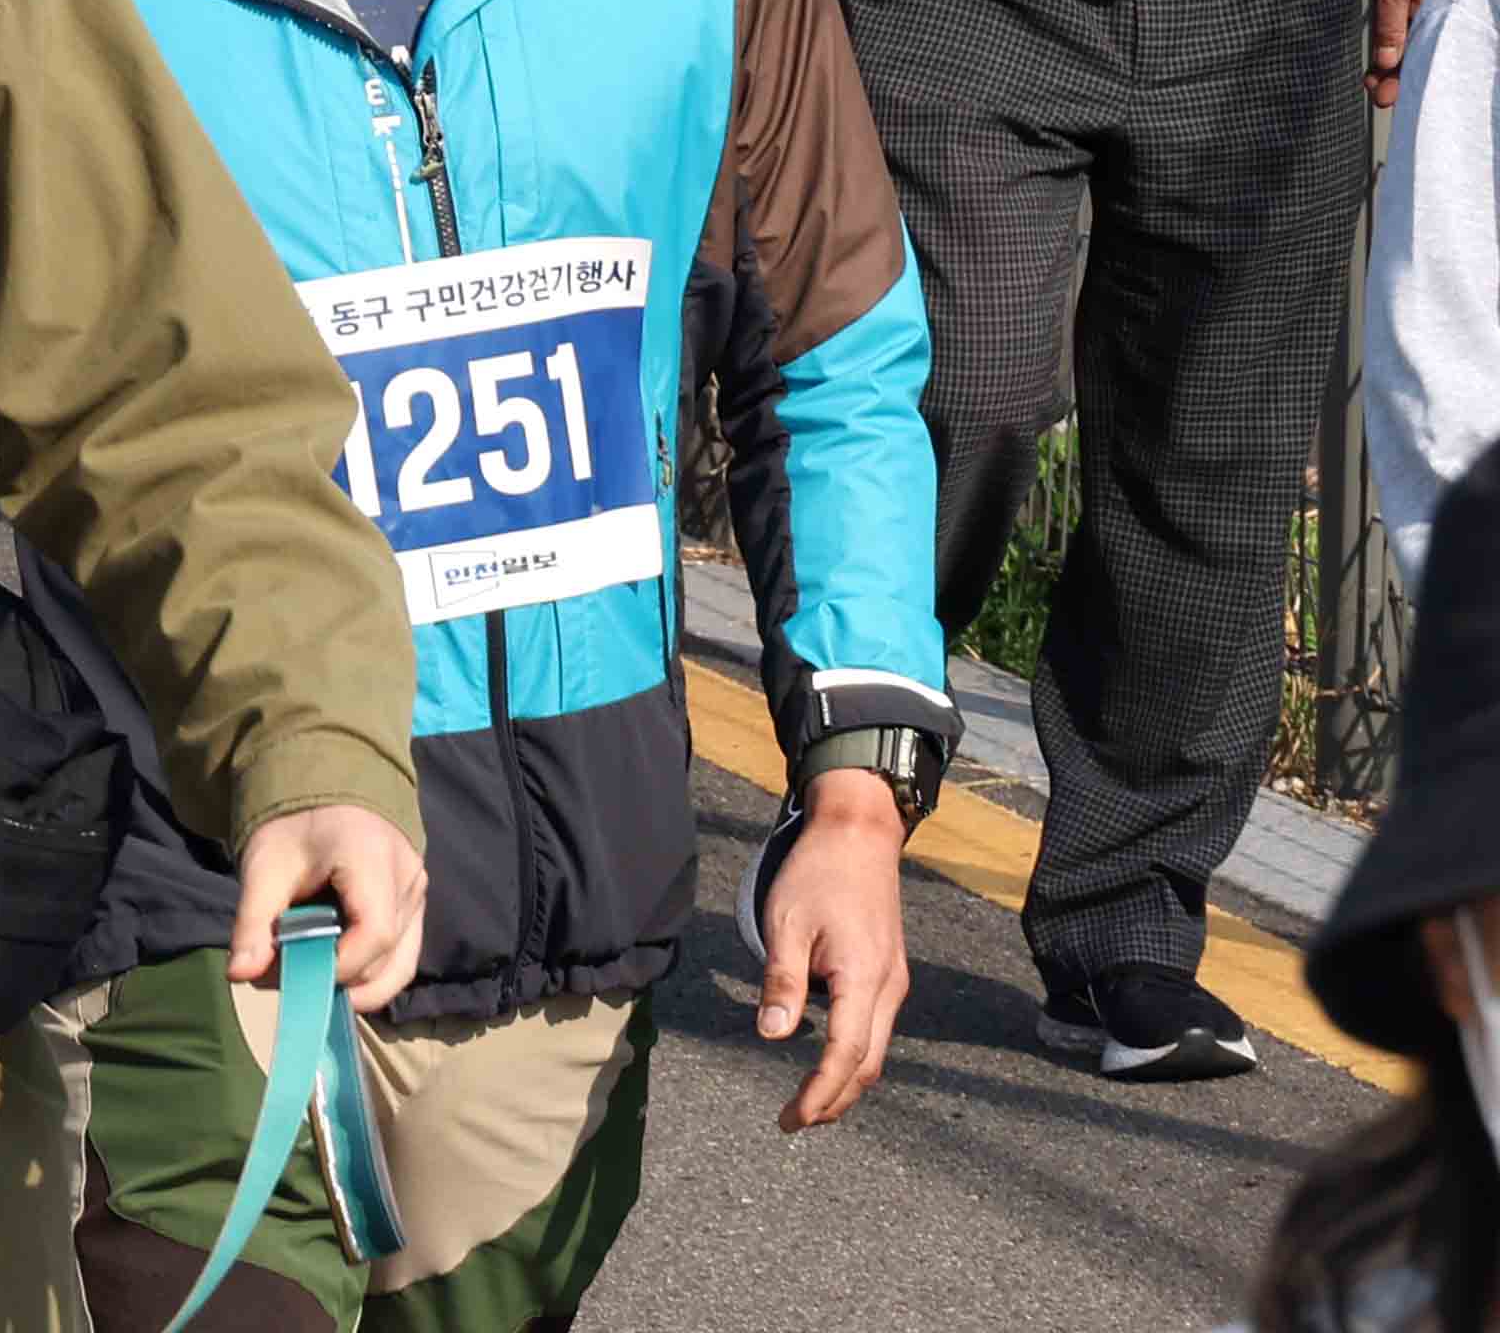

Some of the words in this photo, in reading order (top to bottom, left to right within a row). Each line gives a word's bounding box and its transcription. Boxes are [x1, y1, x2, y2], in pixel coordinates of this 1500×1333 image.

[329, 294, 395, 336] 동구
[405, 259, 637, 323] 구민건강걷기행사
[444, 551, 558, 586] 인천일보
